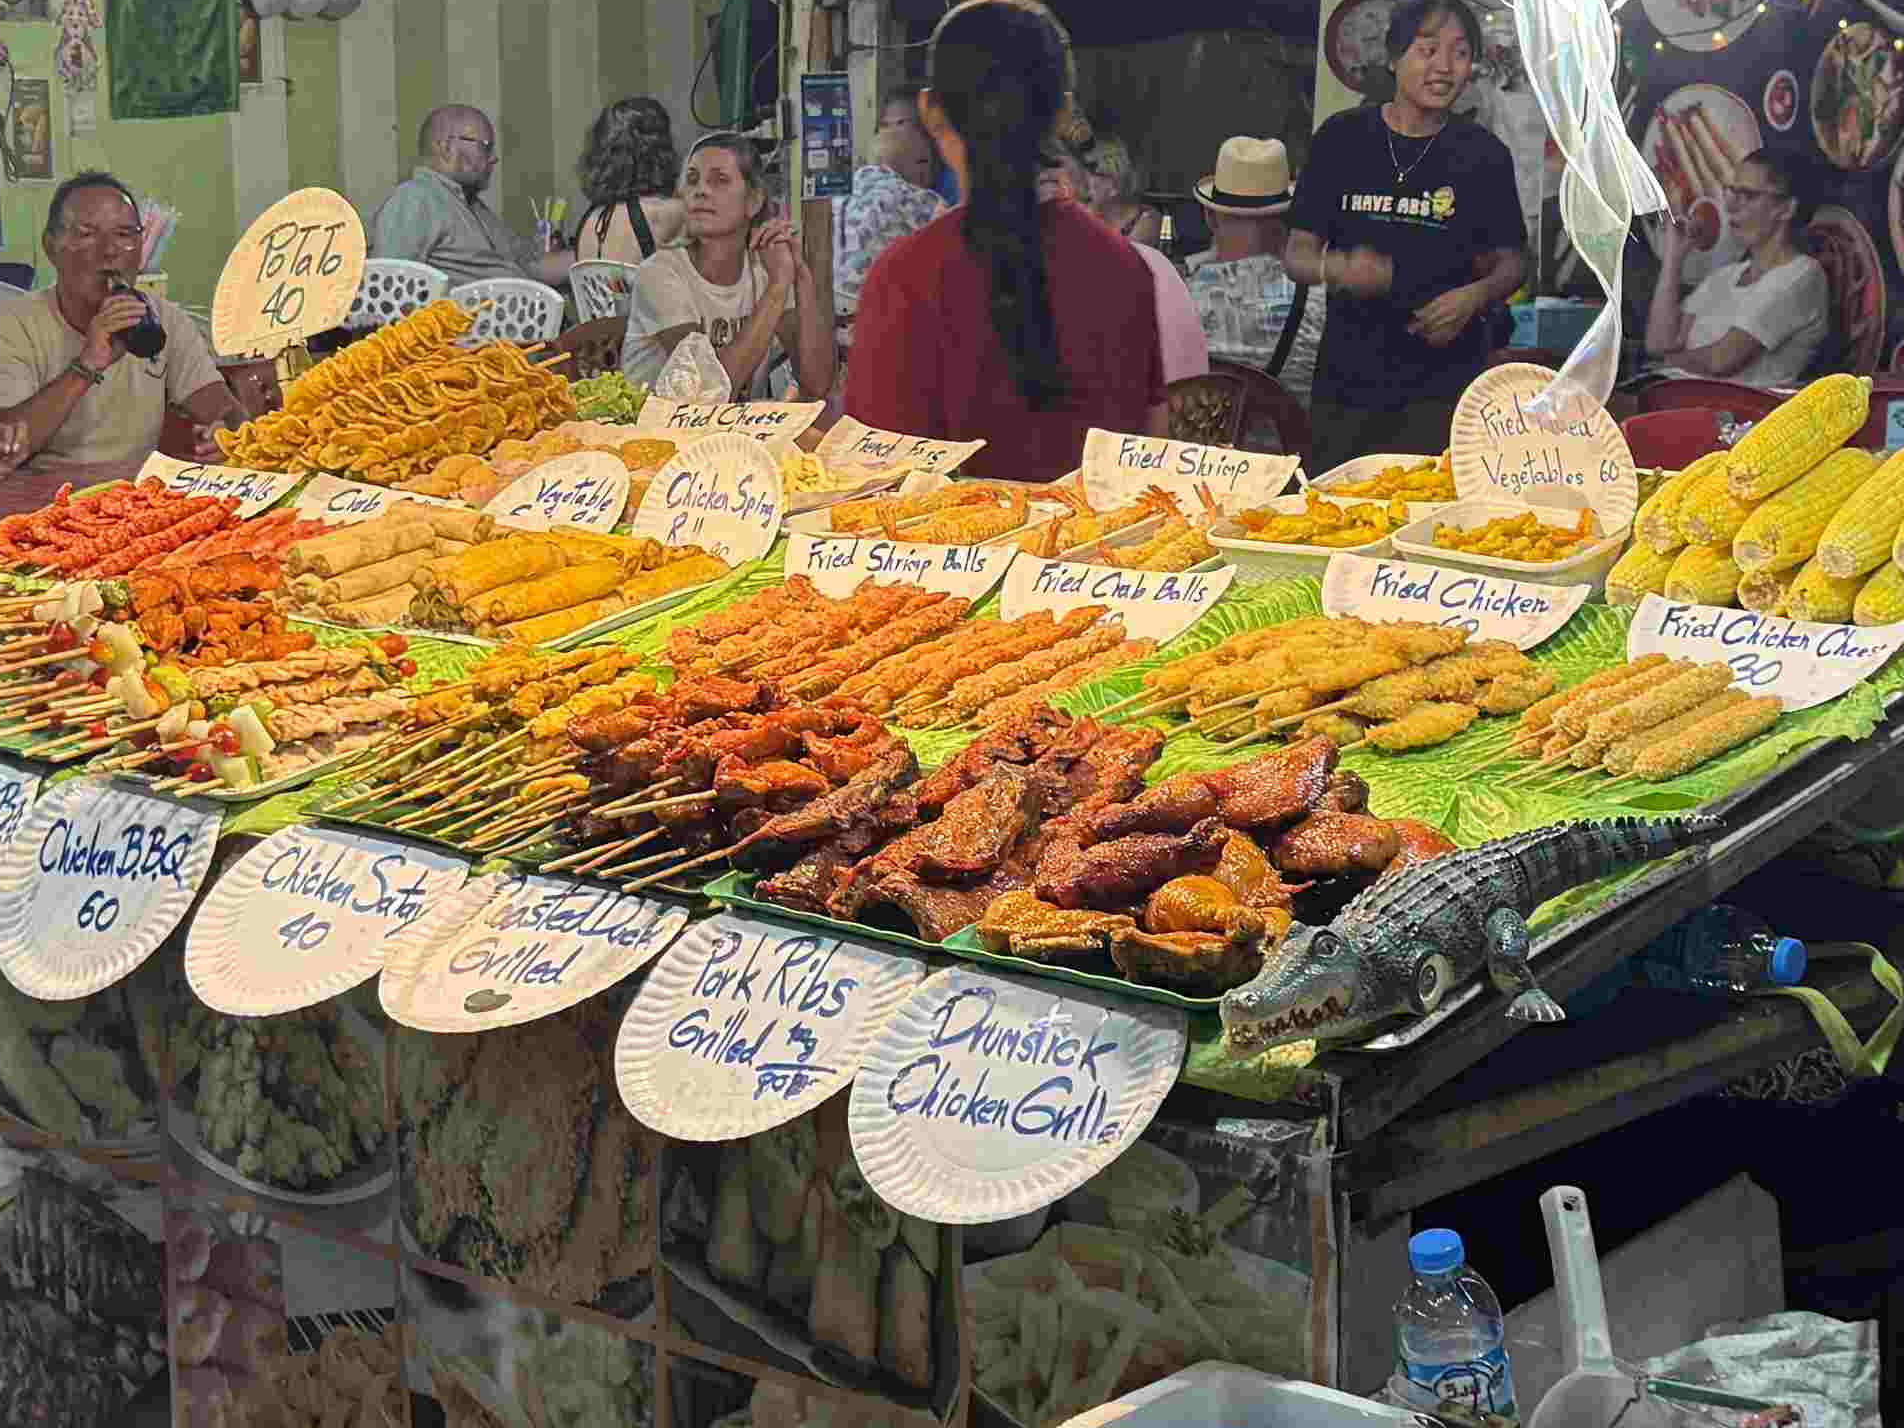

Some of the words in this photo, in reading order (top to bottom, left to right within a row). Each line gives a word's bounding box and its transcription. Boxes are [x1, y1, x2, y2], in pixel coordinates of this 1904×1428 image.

[1341, 194, 1347, 211] I
[1351, 194, 1394, 212] HAVE
[261, 282, 304, 328] 40
[671, 404, 712, 428] Fried
[718, 403, 789, 427] Cheese
[1479, 396, 1532, 440] Fried
[1117, 438, 1167, 469] Fried
[1175, 445, 1251, 492] Shrimp
[1480, 448, 1586, 494] Vegetables
[1599, 457, 1620, 483] 60
[536, 476, 616, 515] Vegetable
[666, 471, 729, 510] Chicken
[807, 537, 859, 574] Fried
[868, 547, 934, 581] Shrimp
[941, 547, 988, 574] Balls
[1032, 563, 1087, 596] Fried
[1091, 569, 1147, 600] Crab
[1152, 575, 1209, 603] Balls
[1370, 563, 1433, 605] Fried
[1439, 577, 1551, 615] Chicken
[1659, 607, 1721, 640] Fried
[1721, 614, 1810, 651] Chicken
[1727, 652, 1783, 686] 30
[39, 818, 114, 878] Chicken
[261, 845, 354, 908] Chicken
[77, 890, 120, 932] 60
[278, 911, 334, 950] 40
[449, 938, 584, 985] Grilled
[691, 932, 763, 1003] Pork
[764, 935, 859, 1019] Ribs
[668, 1009, 778, 1069] Grilled
[928, 985, 1118, 1071] Drumstick
[887, 1055, 1007, 1125] Chicken
